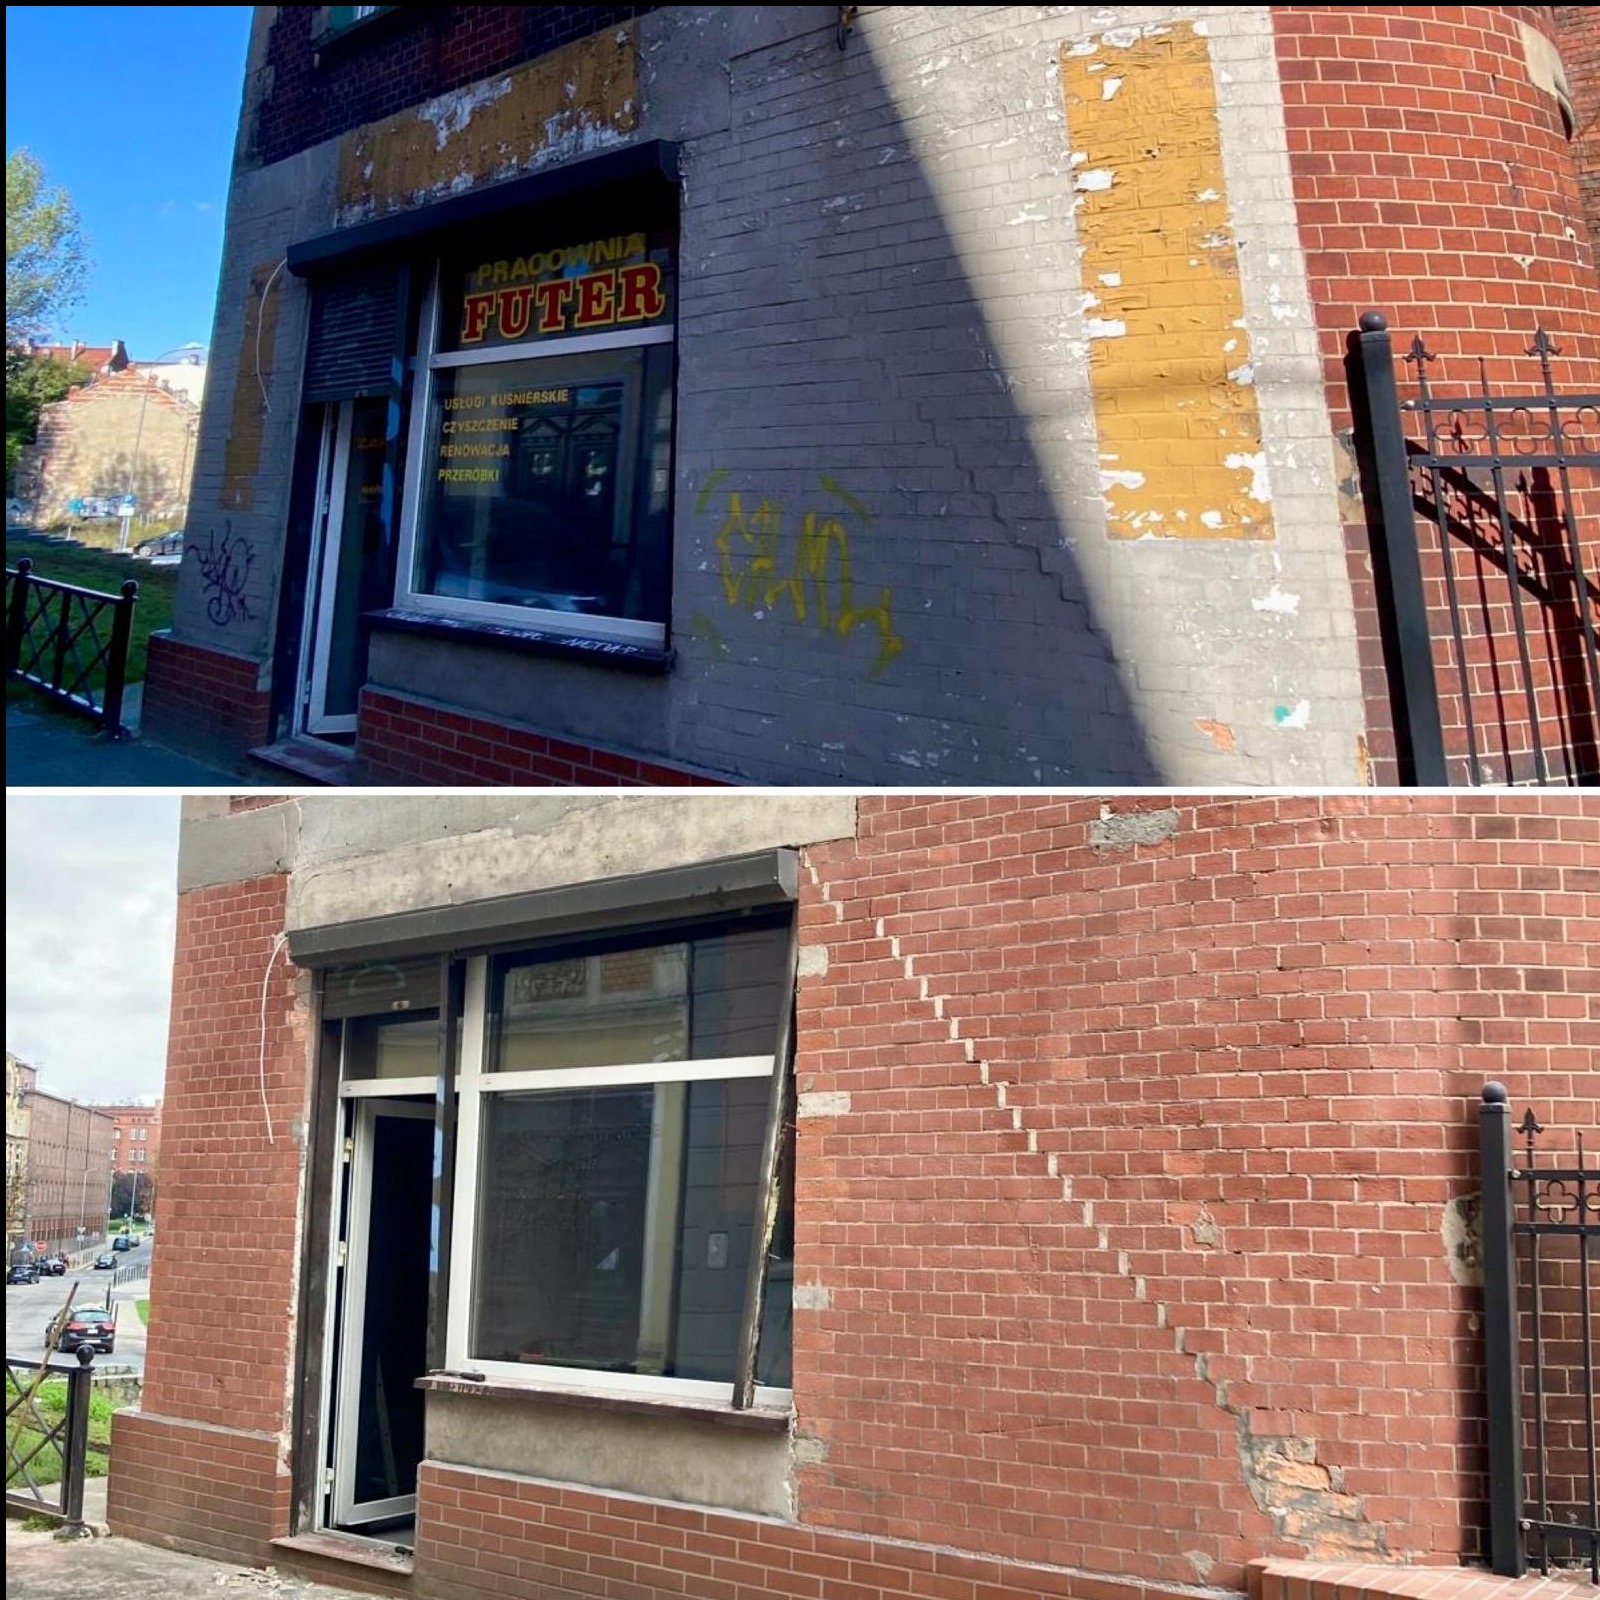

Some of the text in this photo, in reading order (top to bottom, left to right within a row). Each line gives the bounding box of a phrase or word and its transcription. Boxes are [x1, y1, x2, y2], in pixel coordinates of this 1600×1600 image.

[461, 262, 666, 343] FUTER
[442, 417, 519, 434] CZYSZCZENIE
[440, 442, 511, 458] RENOWACJA
